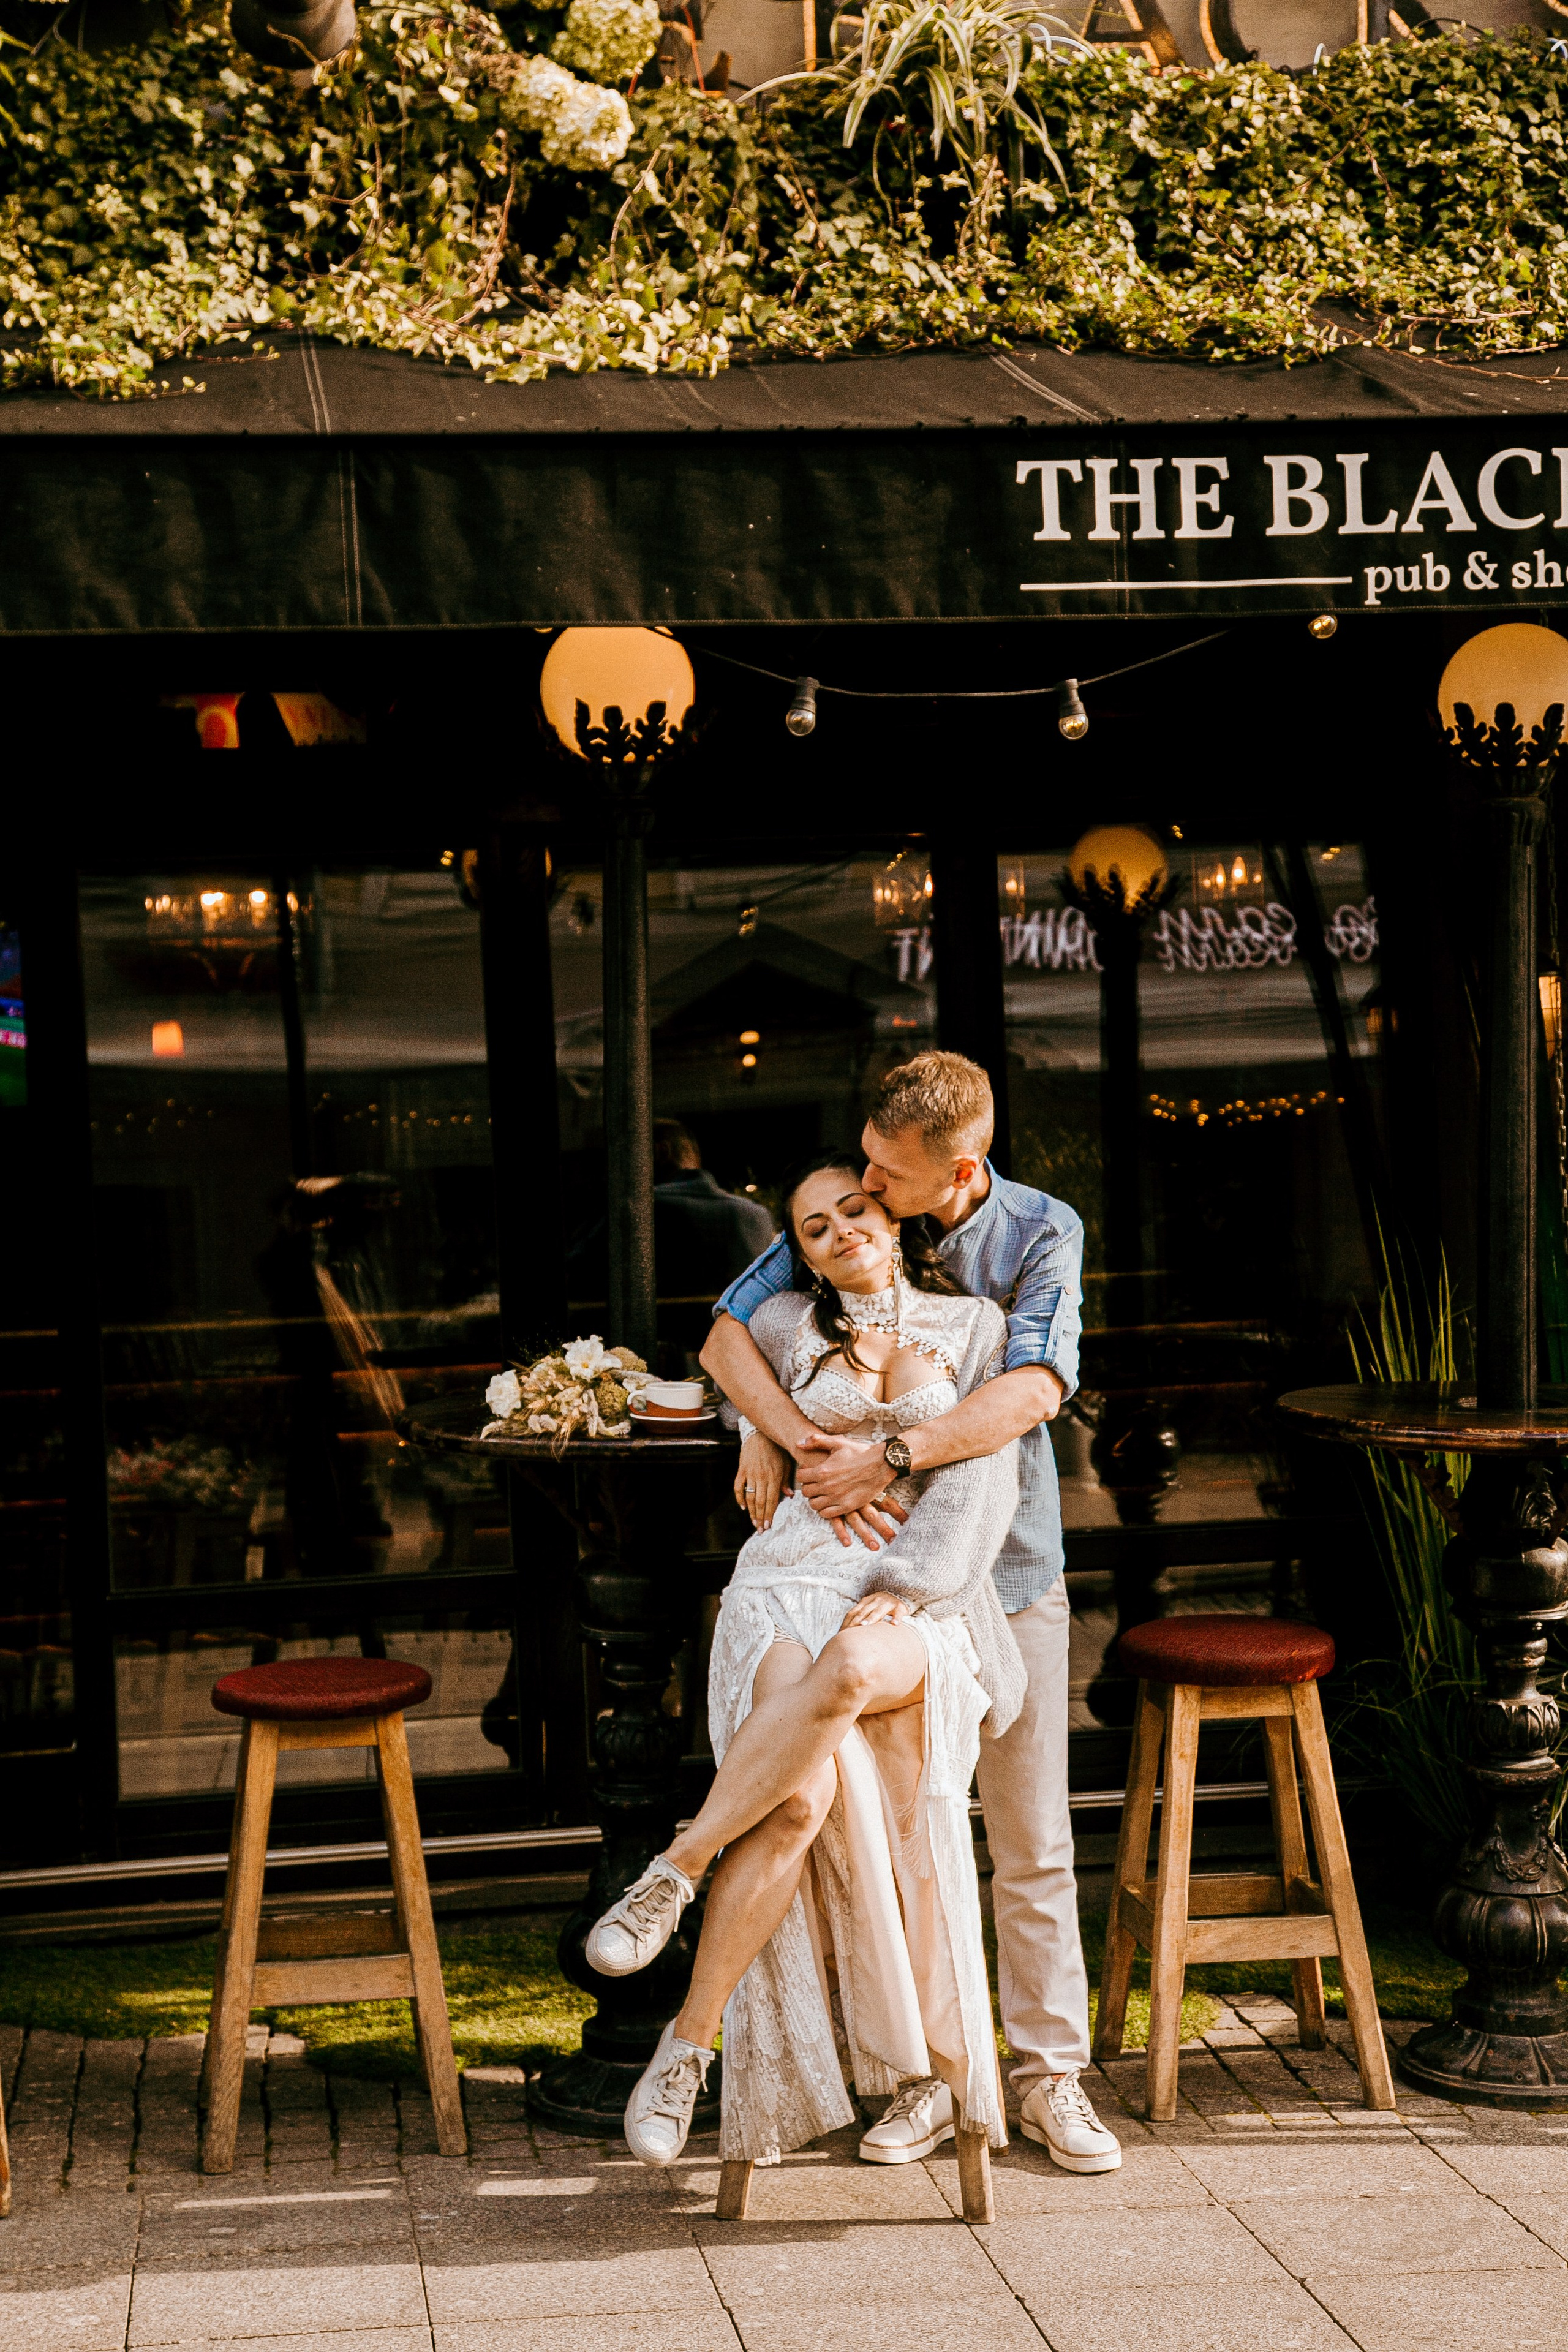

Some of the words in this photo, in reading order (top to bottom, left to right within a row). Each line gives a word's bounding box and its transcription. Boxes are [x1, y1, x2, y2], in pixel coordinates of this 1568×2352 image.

[1016, 456, 1235, 541] THE
[1263, 447, 1568, 537] BLAC
[1363, 552, 1452, 606] pub
[1463, 551, 1499, 590] &
[1512, 549, 1568, 590] sh
